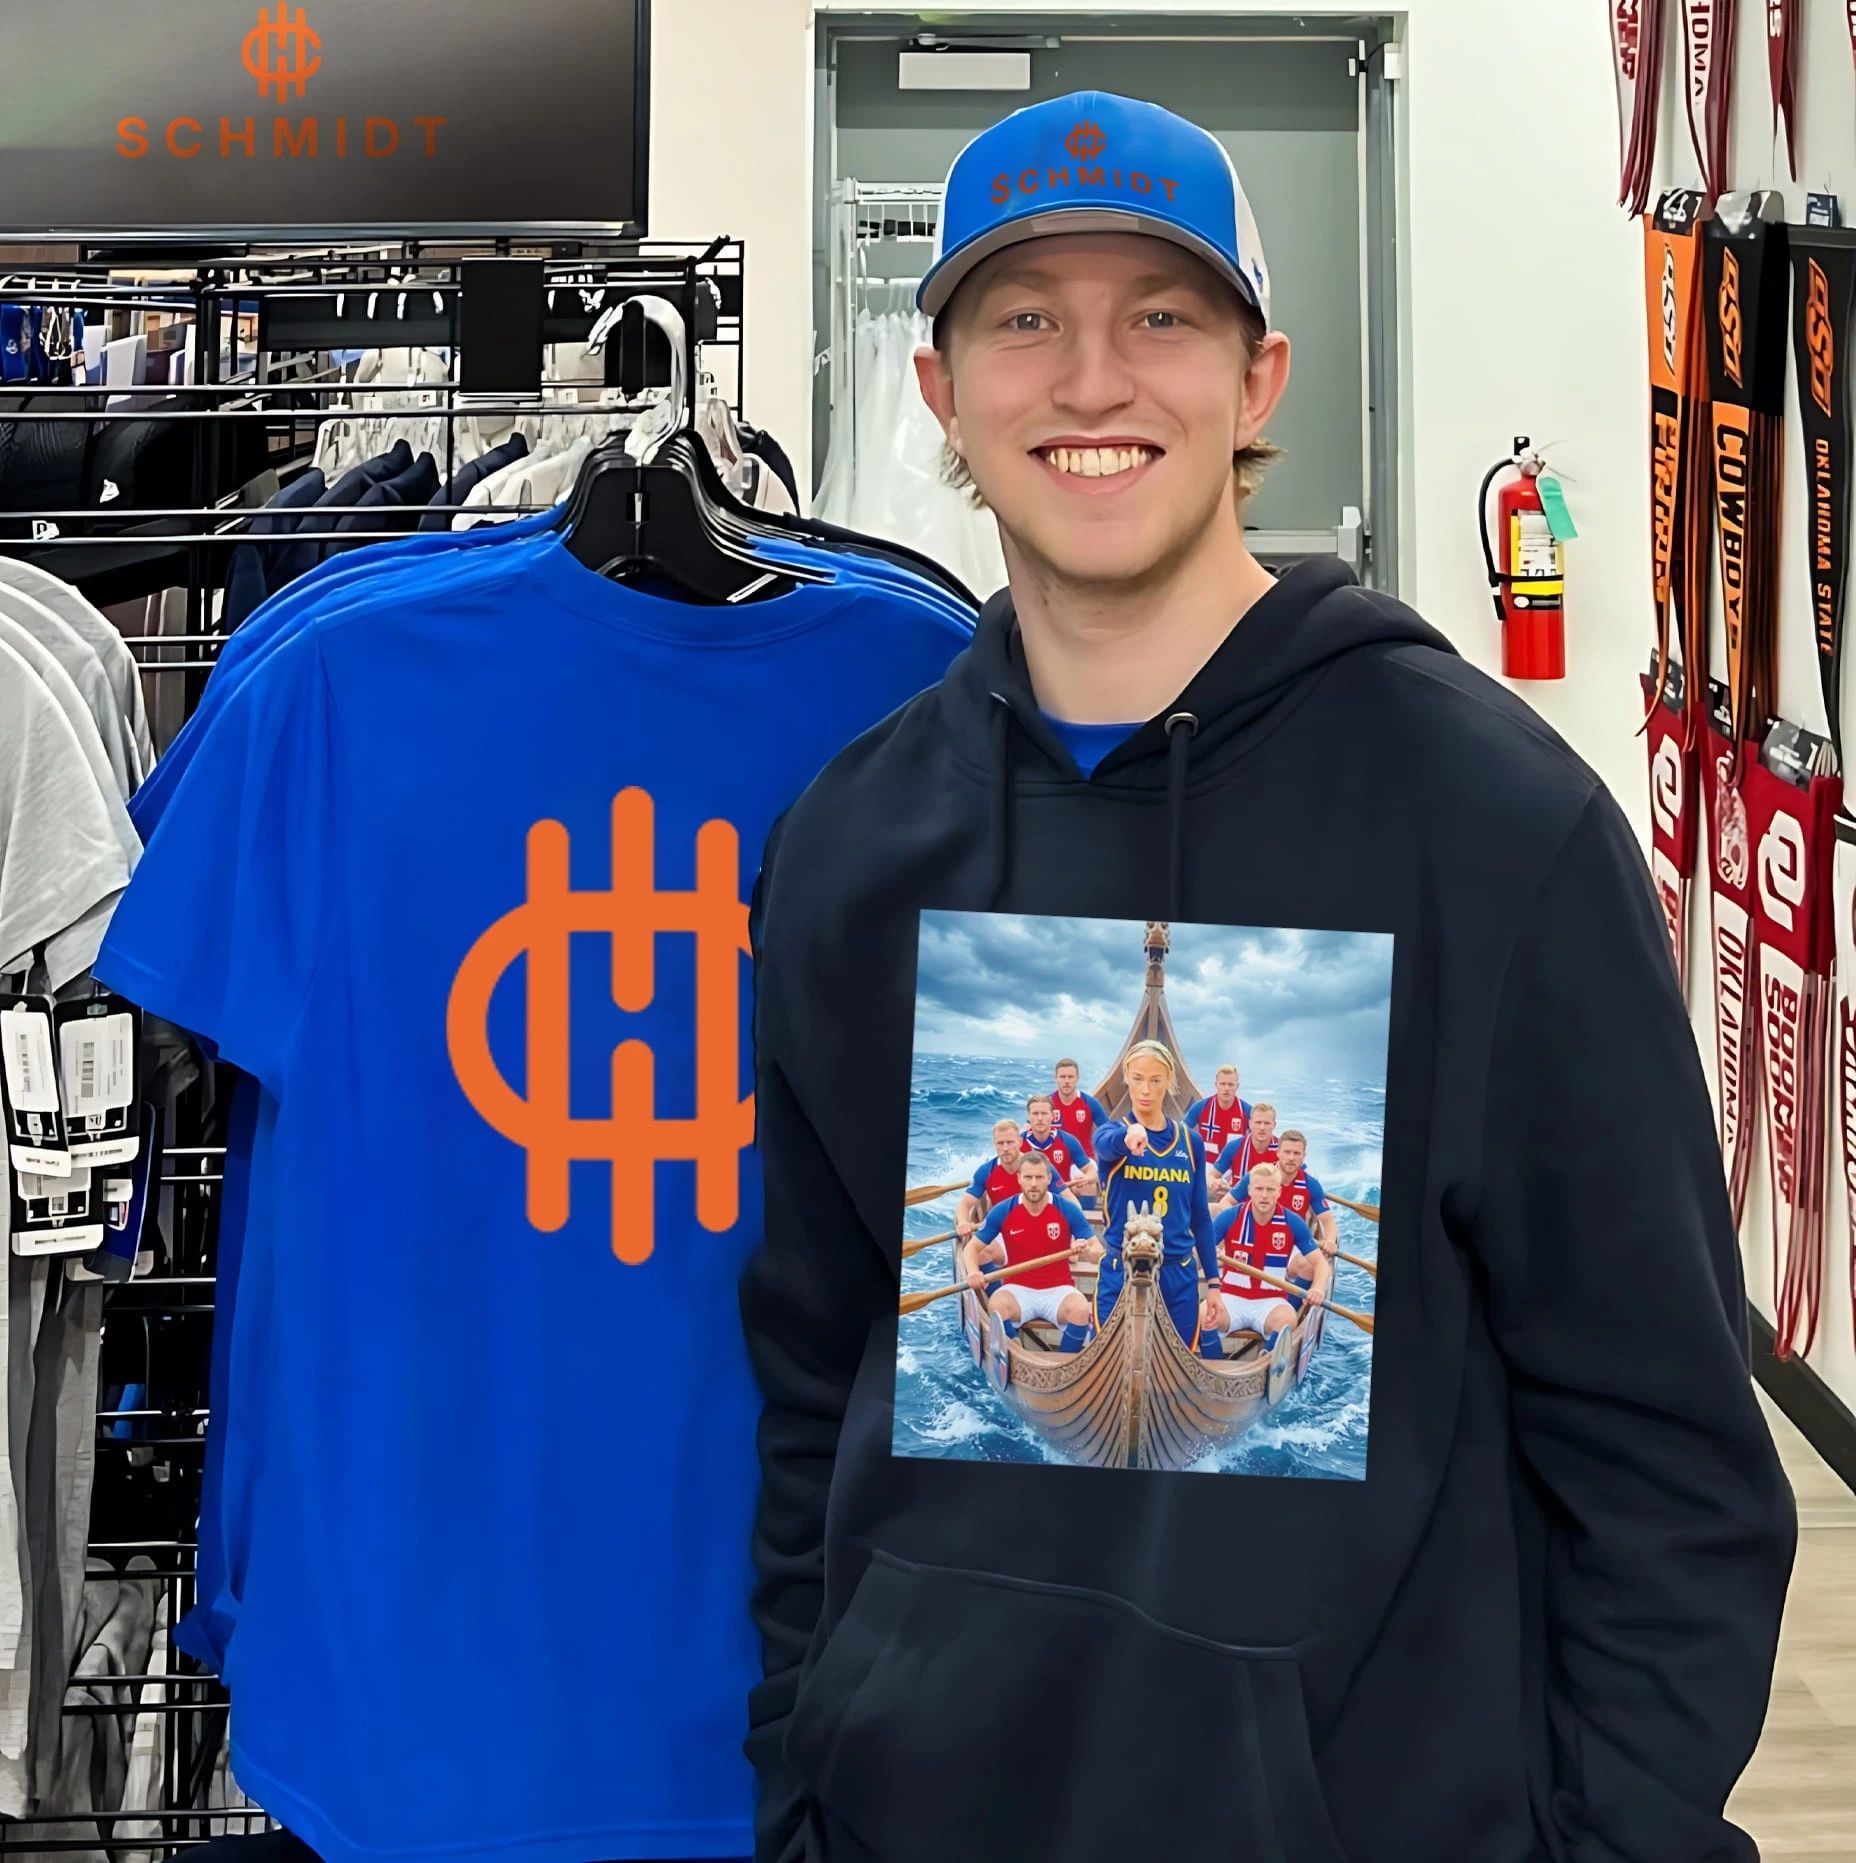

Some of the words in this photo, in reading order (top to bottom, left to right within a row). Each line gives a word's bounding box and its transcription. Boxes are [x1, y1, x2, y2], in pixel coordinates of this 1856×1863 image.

[116, 115, 447, 158] SCHMIDT
[992, 165, 1180, 205] SCHMIDT
[1124, 1165, 1190, 1184] INDIANA
[1153, 1186, 1168, 1217] 8
